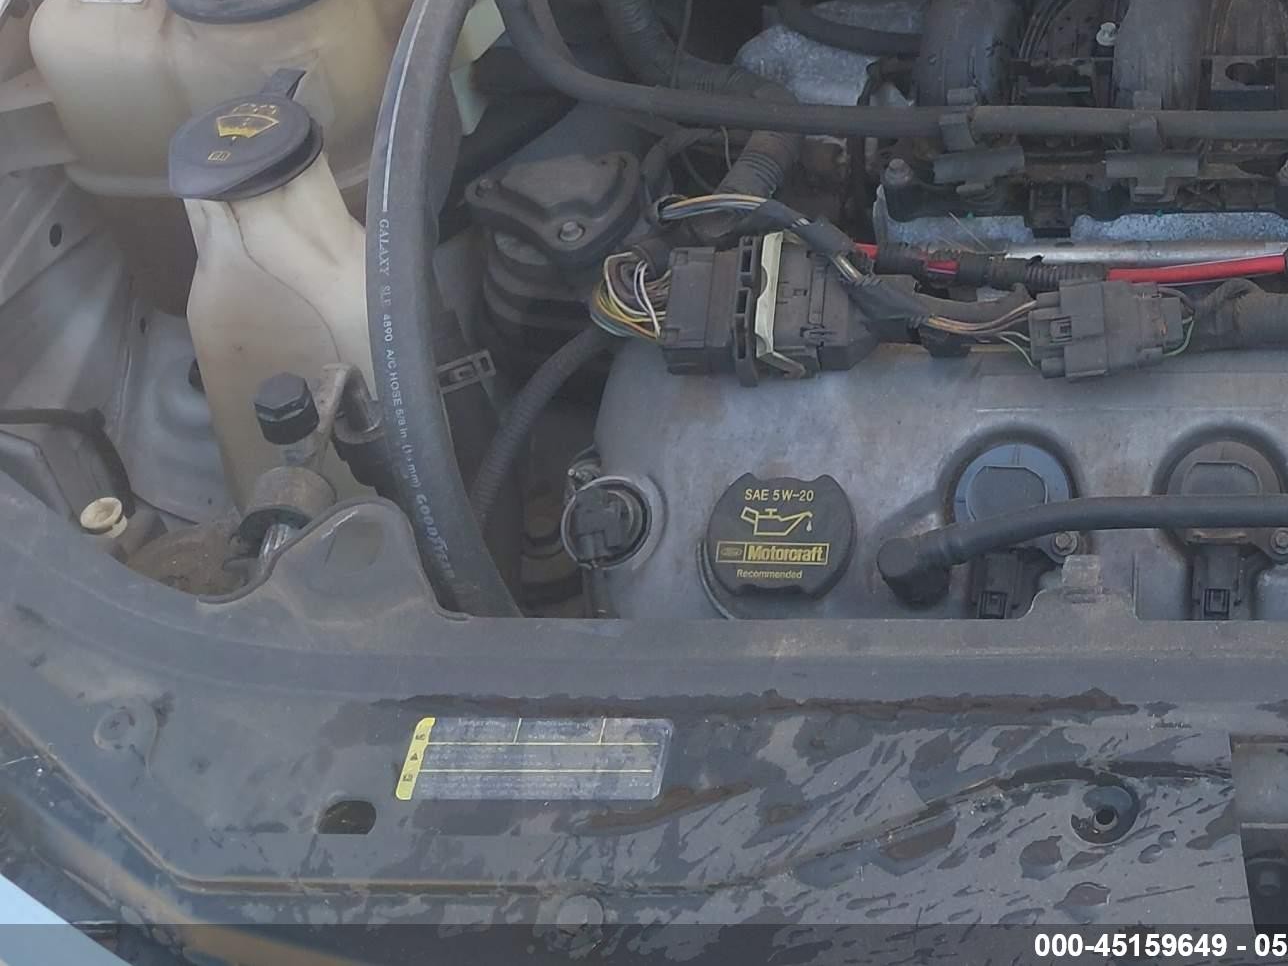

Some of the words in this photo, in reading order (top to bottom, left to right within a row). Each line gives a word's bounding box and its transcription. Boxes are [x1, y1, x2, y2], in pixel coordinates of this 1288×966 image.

[379, 218, 390, 276] GALAXY
[383, 314, 393, 341] 4890
[389, 372, 402, 406] HOSE
[744, 489, 769, 501] SAE
[748, 544, 824, 562] Motorcraft
[736, 568, 803, 579] Recommended
